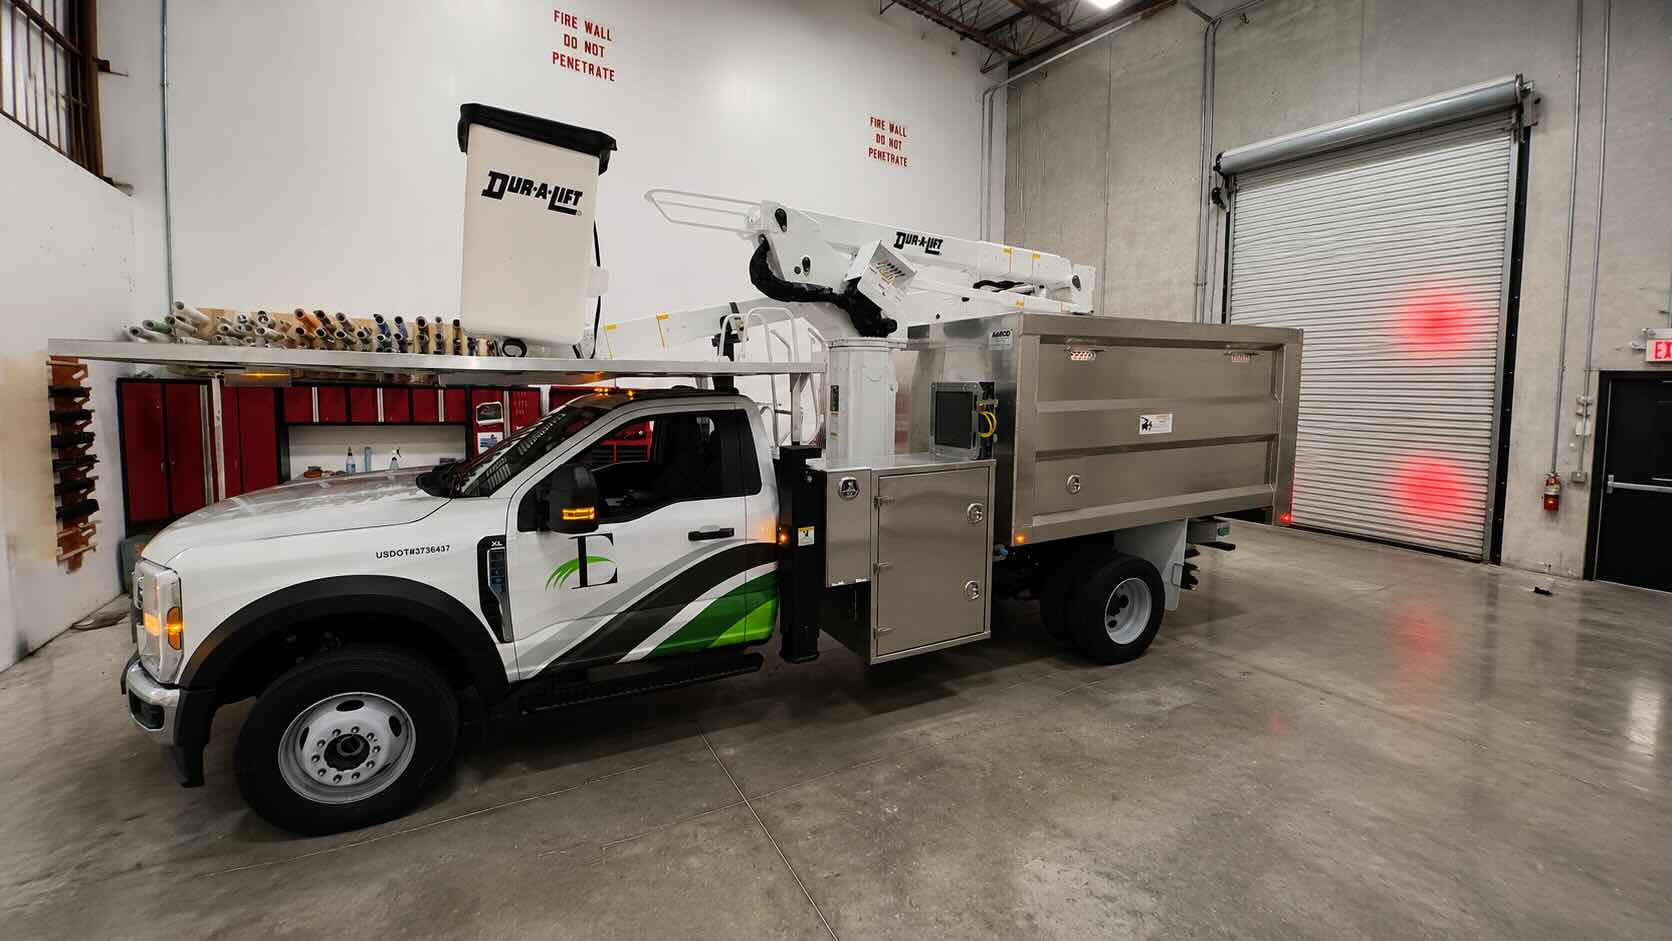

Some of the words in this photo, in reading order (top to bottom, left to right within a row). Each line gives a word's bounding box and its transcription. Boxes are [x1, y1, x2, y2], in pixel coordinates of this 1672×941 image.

[553, 9, 578, 30] FIRE
[584, 20, 612, 42] WALL
[563, 33, 578, 50] DO
[584, 41, 605, 58] NOT
[552, 51, 615, 82] PENETRATE
[870, 116, 886, 131] FIRE
[889, 123, 907, 138] WALL
[876, 133, 886, 145] DO
[888, 137, 902, 151] NOT
[868, 147, 908, 167] PENETRATE
[376, 544, 450, 559] USDOT#3736437
